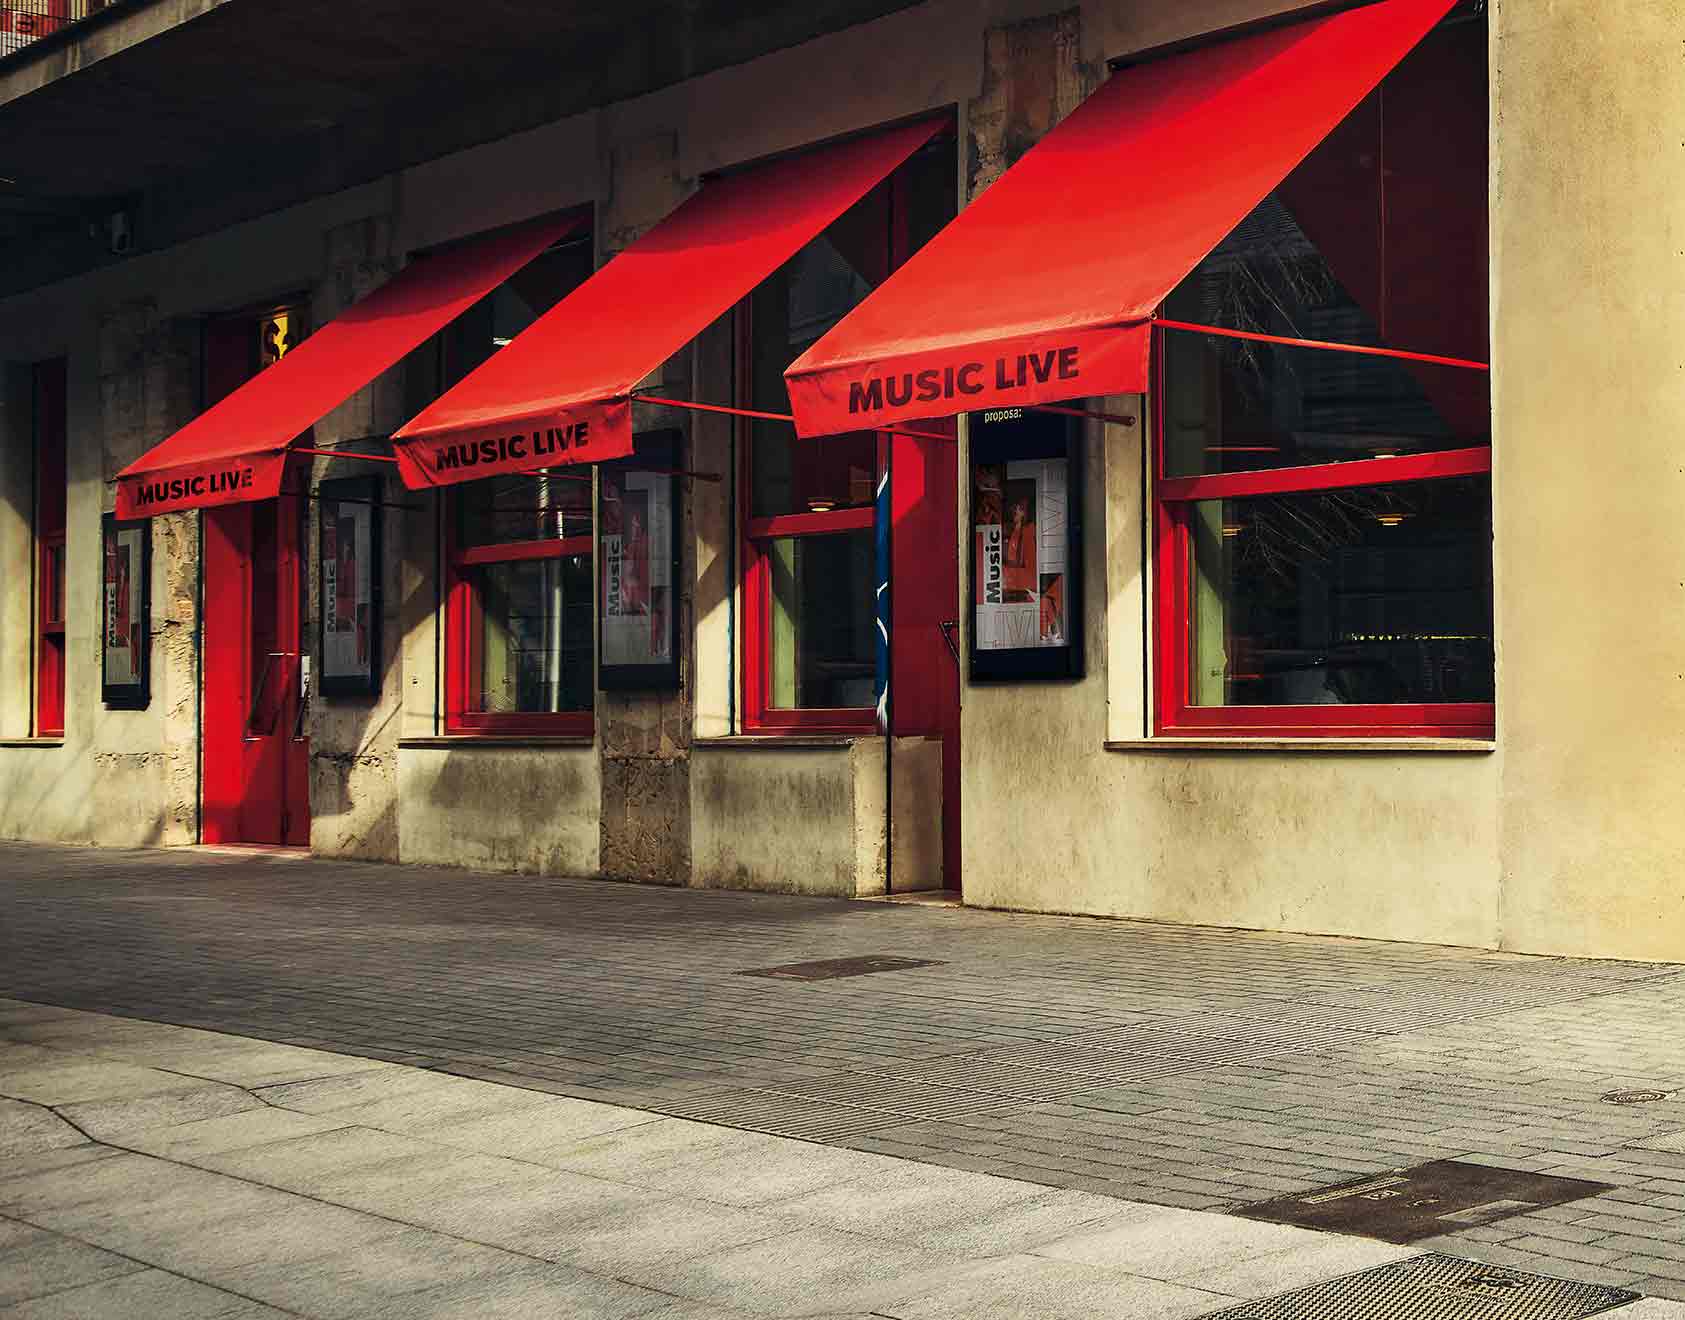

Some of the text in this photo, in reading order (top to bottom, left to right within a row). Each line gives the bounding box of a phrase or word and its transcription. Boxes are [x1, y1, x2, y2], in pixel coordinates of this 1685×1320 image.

[848, 346, 1079, 413] MUSIC LIVE
[436, 421, 589, 471] MUSIC LIVE
[984, 407, 1022, 423] proposa:
[136, 468, 252, 506] MUSIC LIVE
[326, 562, 337, 633] Music
[608, 537, 622, 617] Music
[985, 530, 1001, 604] Music
